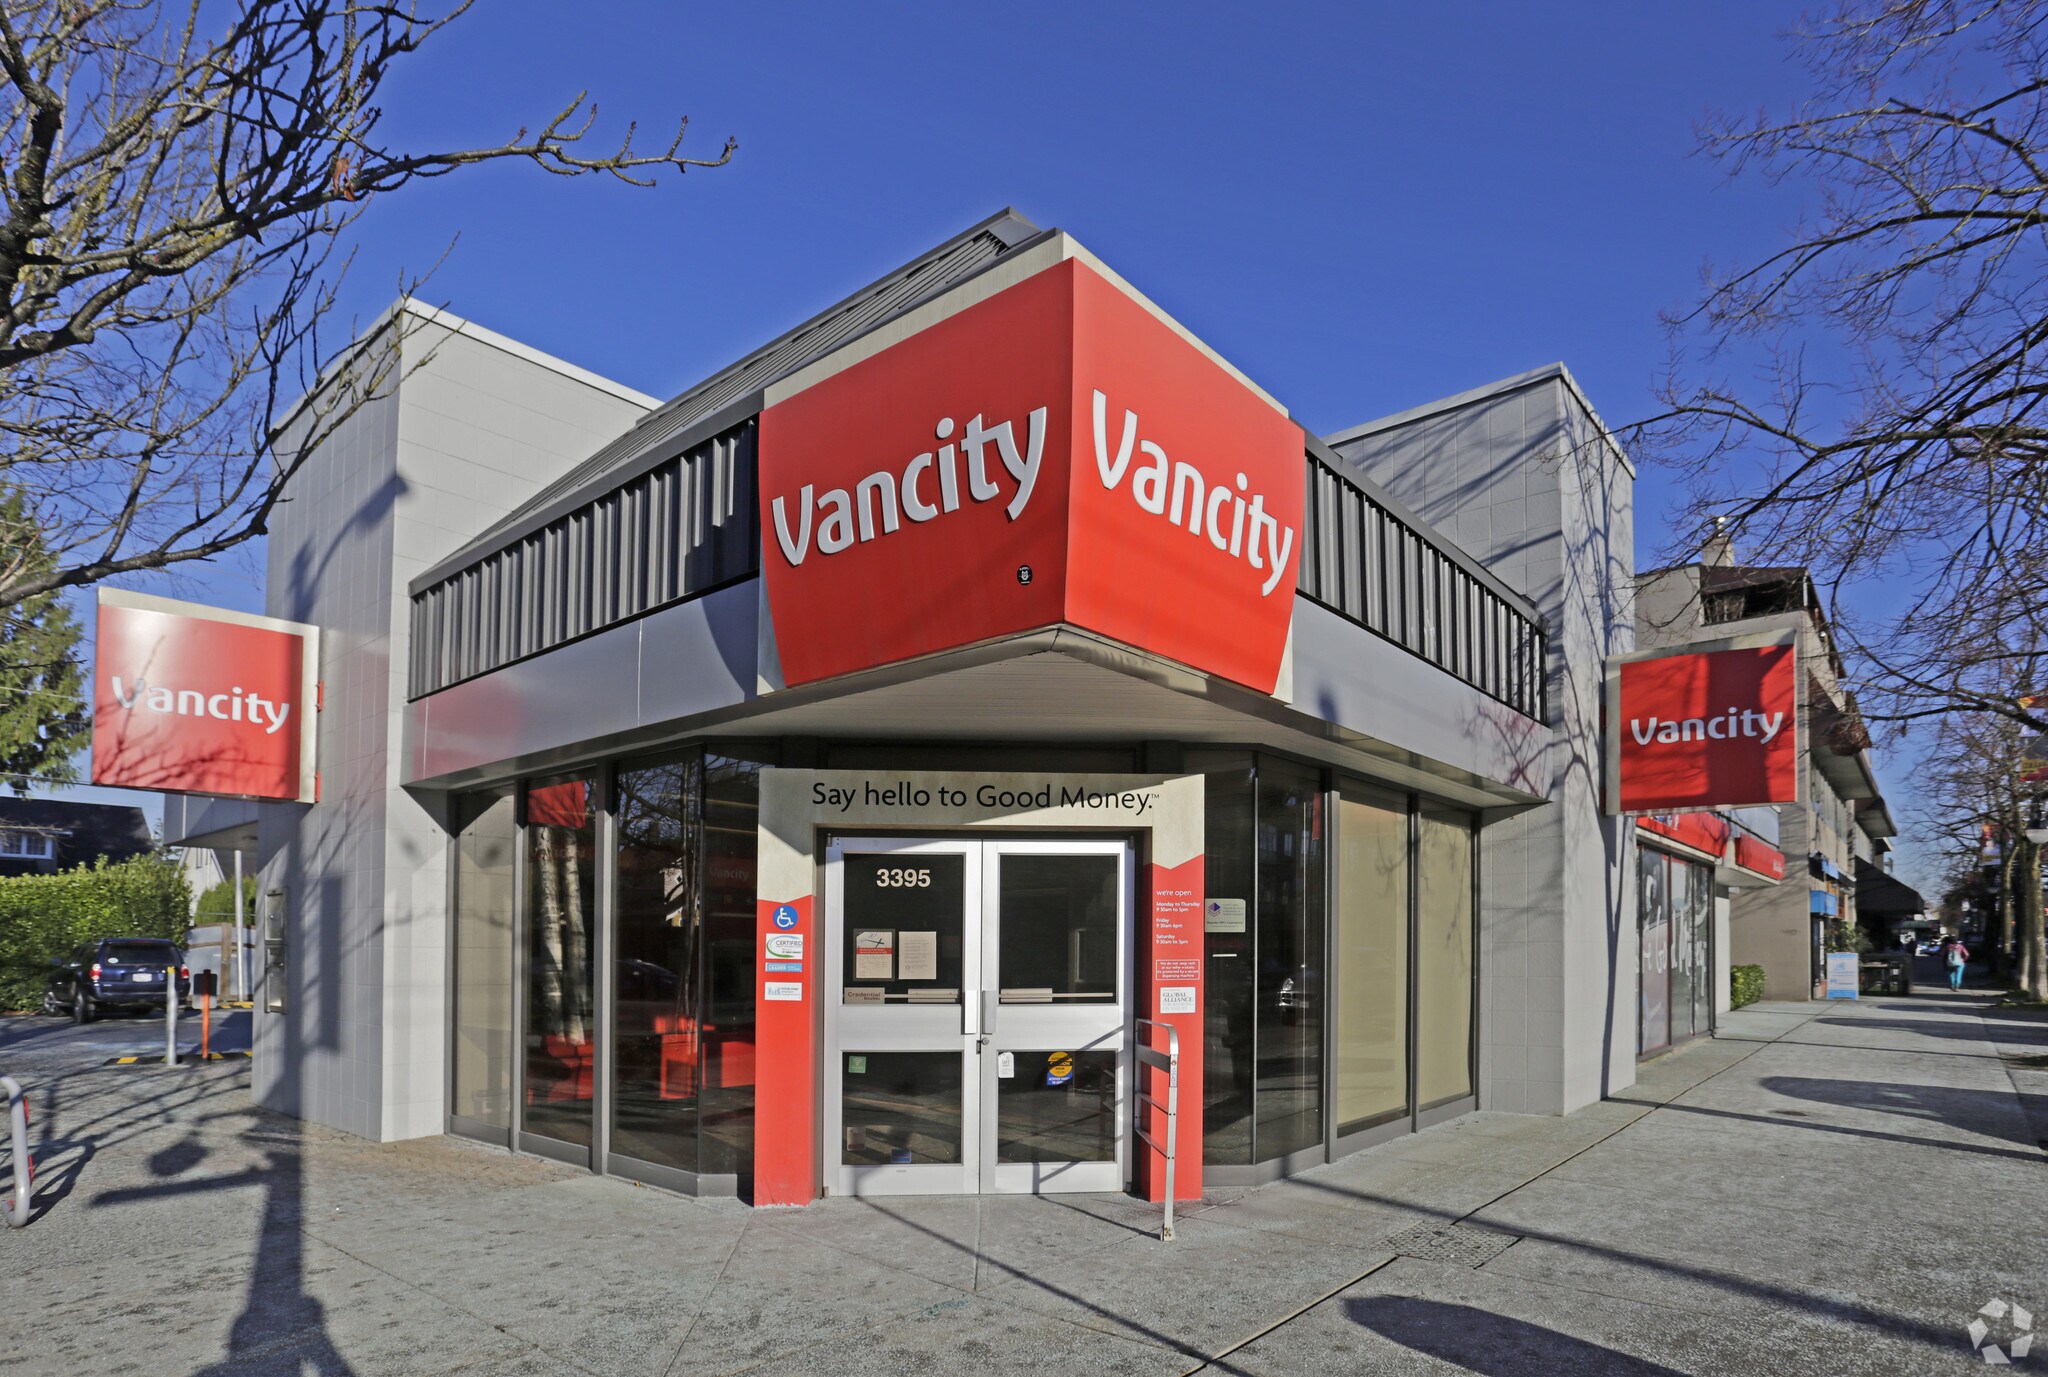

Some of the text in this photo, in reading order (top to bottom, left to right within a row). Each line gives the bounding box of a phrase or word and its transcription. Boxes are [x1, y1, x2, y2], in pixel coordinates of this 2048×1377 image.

[772, 405, 1048, 568] Vancity
[1093, 387, 1294, 598] Vancity
[112, 676, 290, 735] Vancity
[1630, 706, 1784, 746] Vancity
[812, 782, 857, 813] Say
[865, 780, 931, 807] hello
[938, 786, 967, 807] to
[976, 784, 1051, 808] Good
[876, 868, 931, 888] 3395
